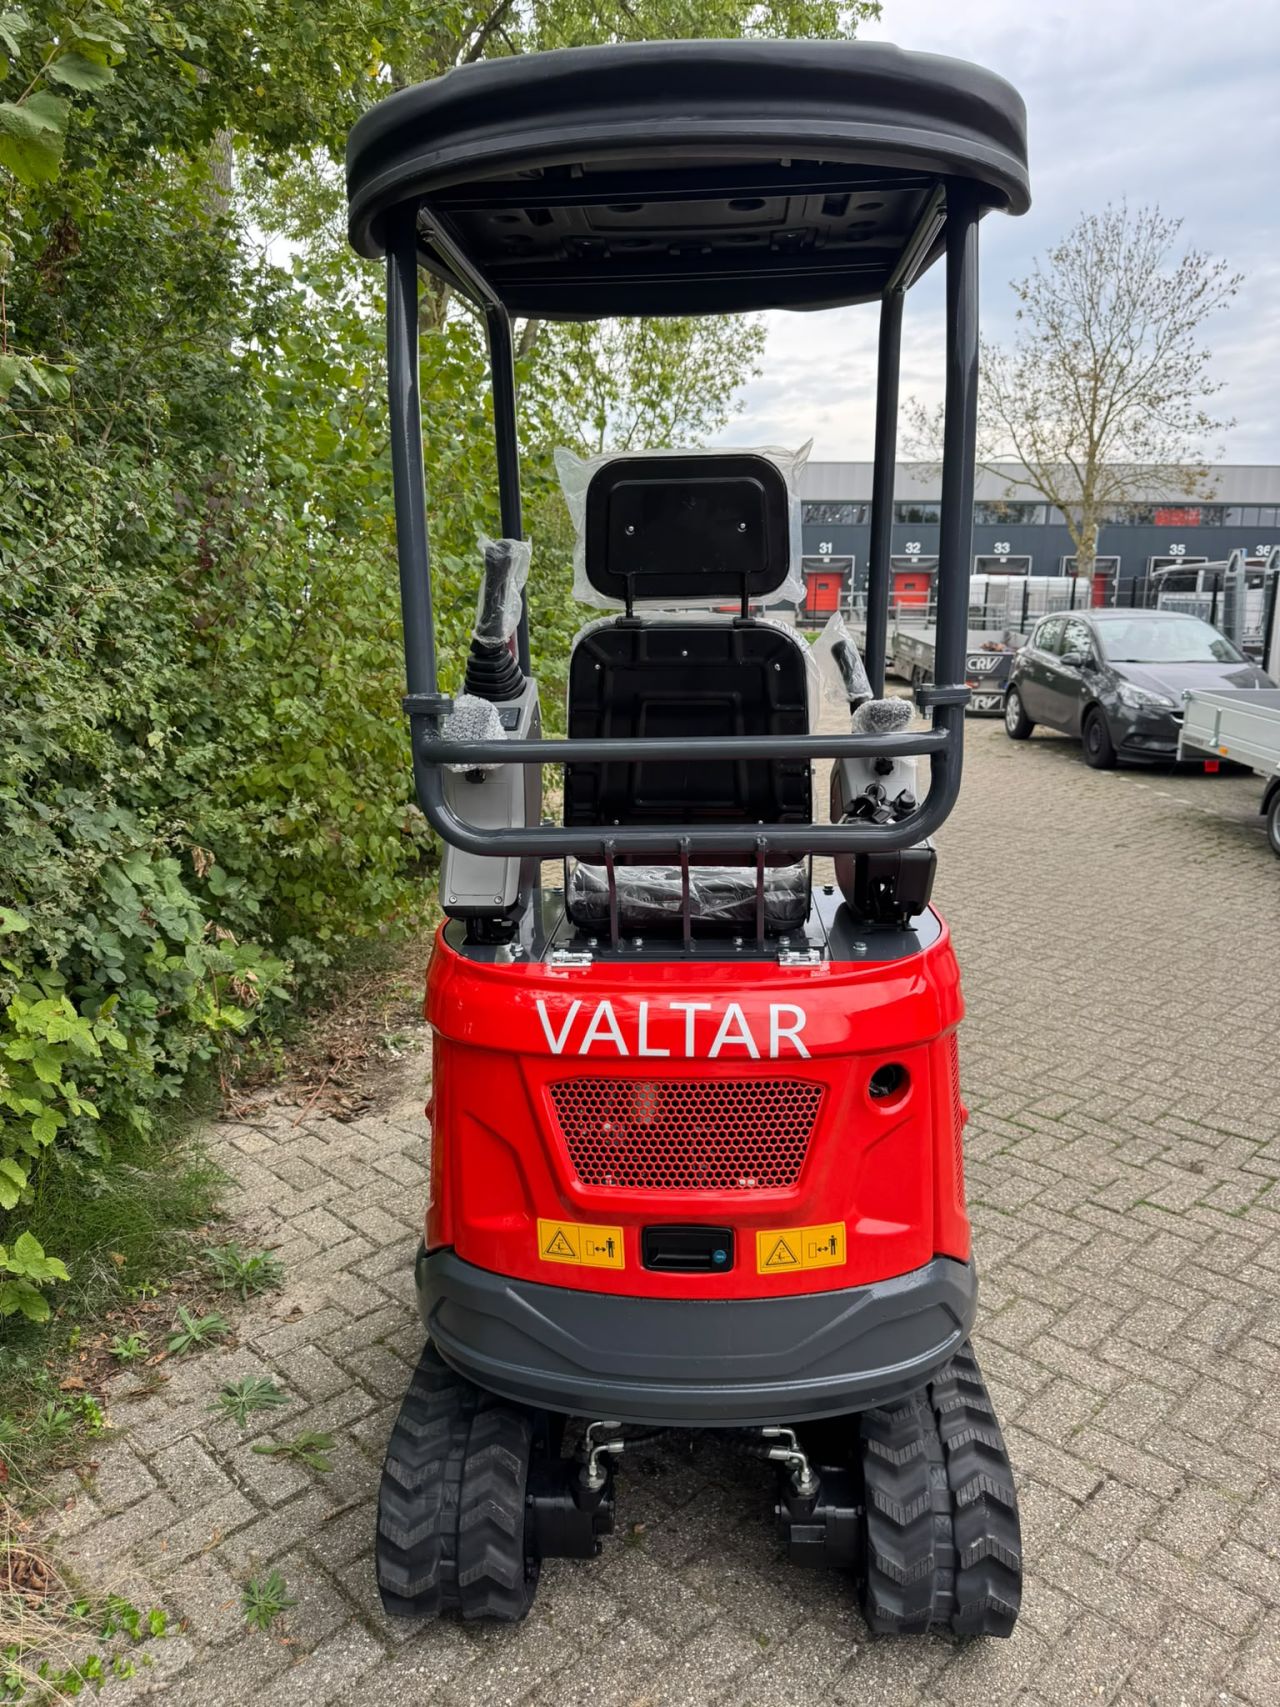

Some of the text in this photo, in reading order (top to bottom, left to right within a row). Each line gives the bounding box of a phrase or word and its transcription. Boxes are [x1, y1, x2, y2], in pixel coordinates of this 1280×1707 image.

[818, 542, 833, 554] 31
[905, 542, 921, 554] 32
[993, 542, 1011, 554] 33
[1169, 544, 1186, 556] 35
[968, 657, 999, 670] CRV
[536, 1000, 812, 1059] VALTAR
